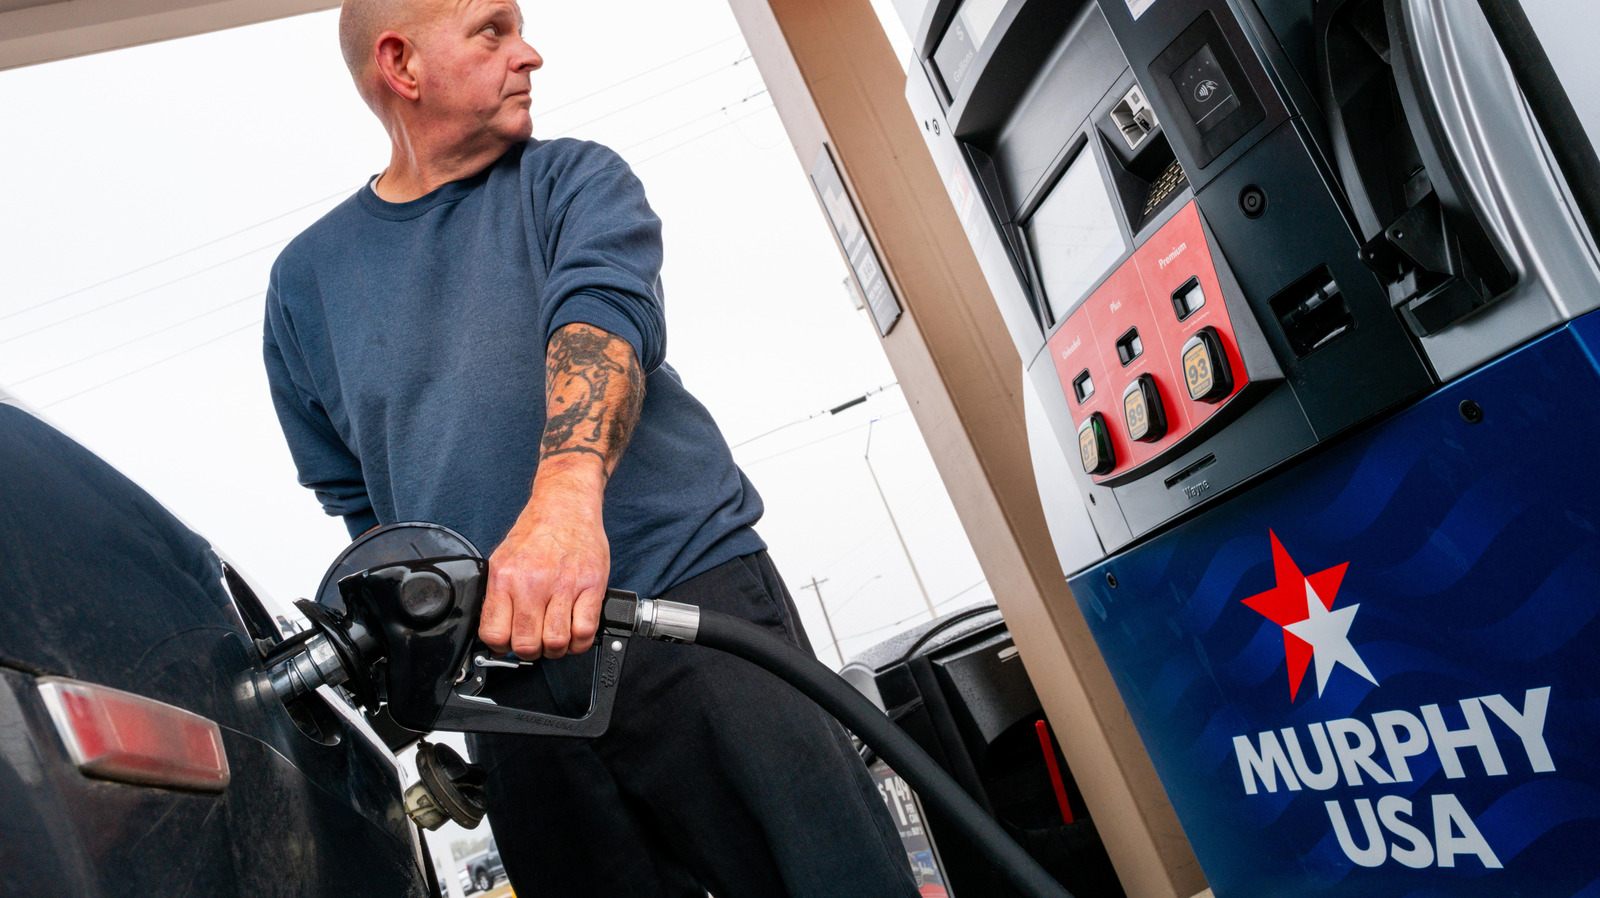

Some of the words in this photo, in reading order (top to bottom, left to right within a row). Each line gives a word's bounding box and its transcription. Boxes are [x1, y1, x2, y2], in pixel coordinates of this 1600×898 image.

[953, 49, 974, 82] Gallons
[1158, 242, 1187, 270] Premium
[1109, 300, 1122, 314] Plus
[1062, 335, 1081, 360] Unleaded
[1188, 358, 1209, 386] 93
[1128, 403, 1145, 428] 89
[1082, 439, 1095, 462] 87
[1182, 479, 1210, 500] Wayne
[1232, 685, 1557, 796] MURPHY
[1324, 793, 1505, 870] USA
